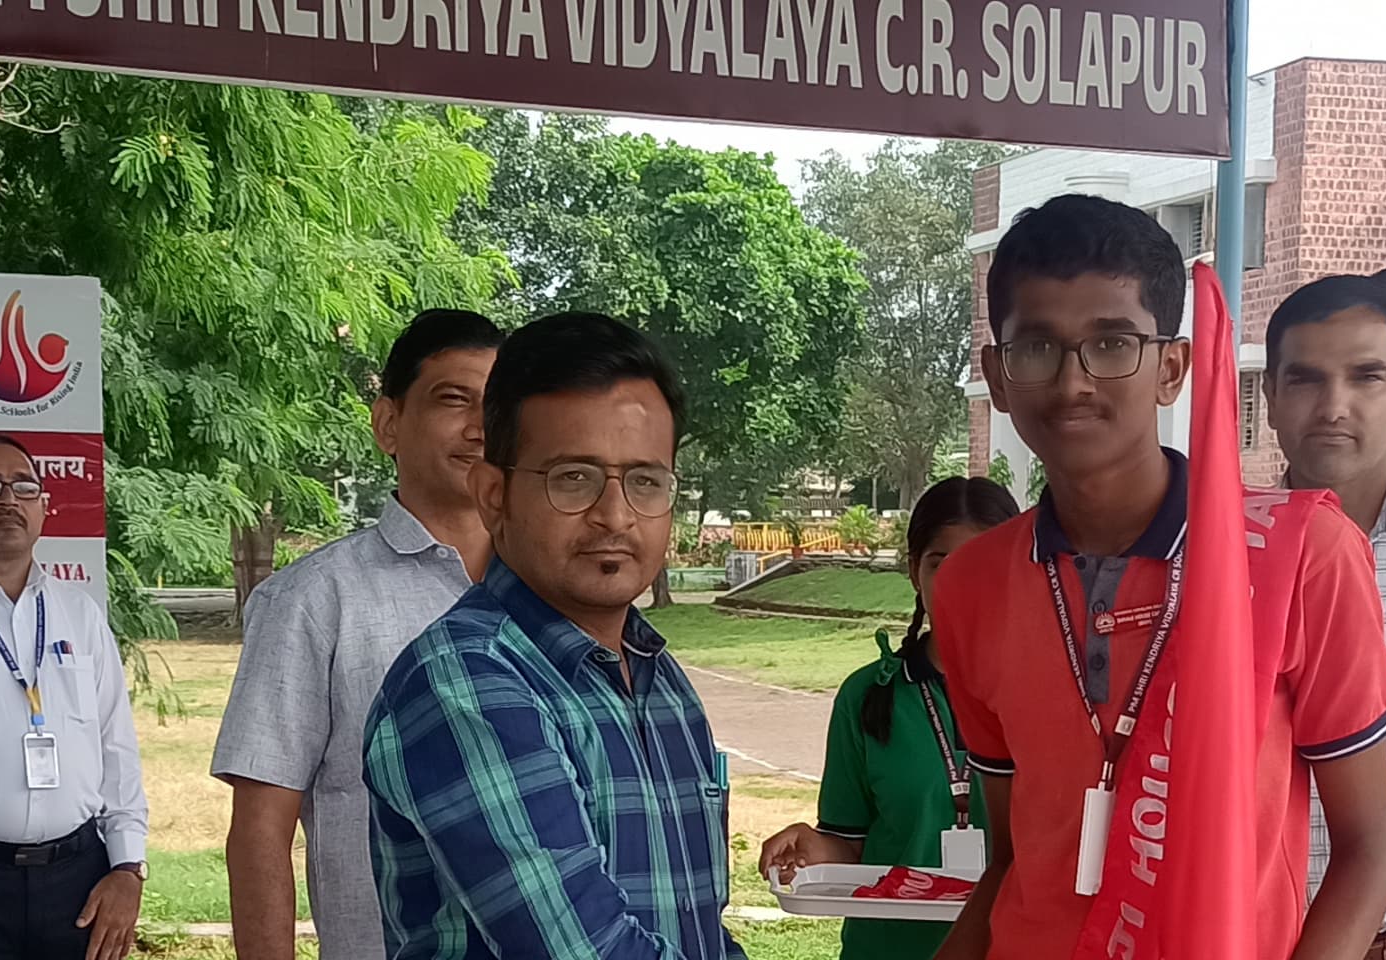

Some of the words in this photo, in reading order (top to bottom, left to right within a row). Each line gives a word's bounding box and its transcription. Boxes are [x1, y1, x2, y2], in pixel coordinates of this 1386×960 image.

[565, 0, 862, 88] VIDYALAYA
[875, 0, 969, 99] C.R.
[982, 0, 1207, 116] SOLAPUR
[36, 402, 50, 413] for
[49, 384, 73, 406] Rising
[68, 361, 83, 385] India
[1134, 674, 1148, 699] SHRI
[1143, 630, 1166, 675] KENDRIYA
[1161, 582, 1179, 629] VIDYALAYA
